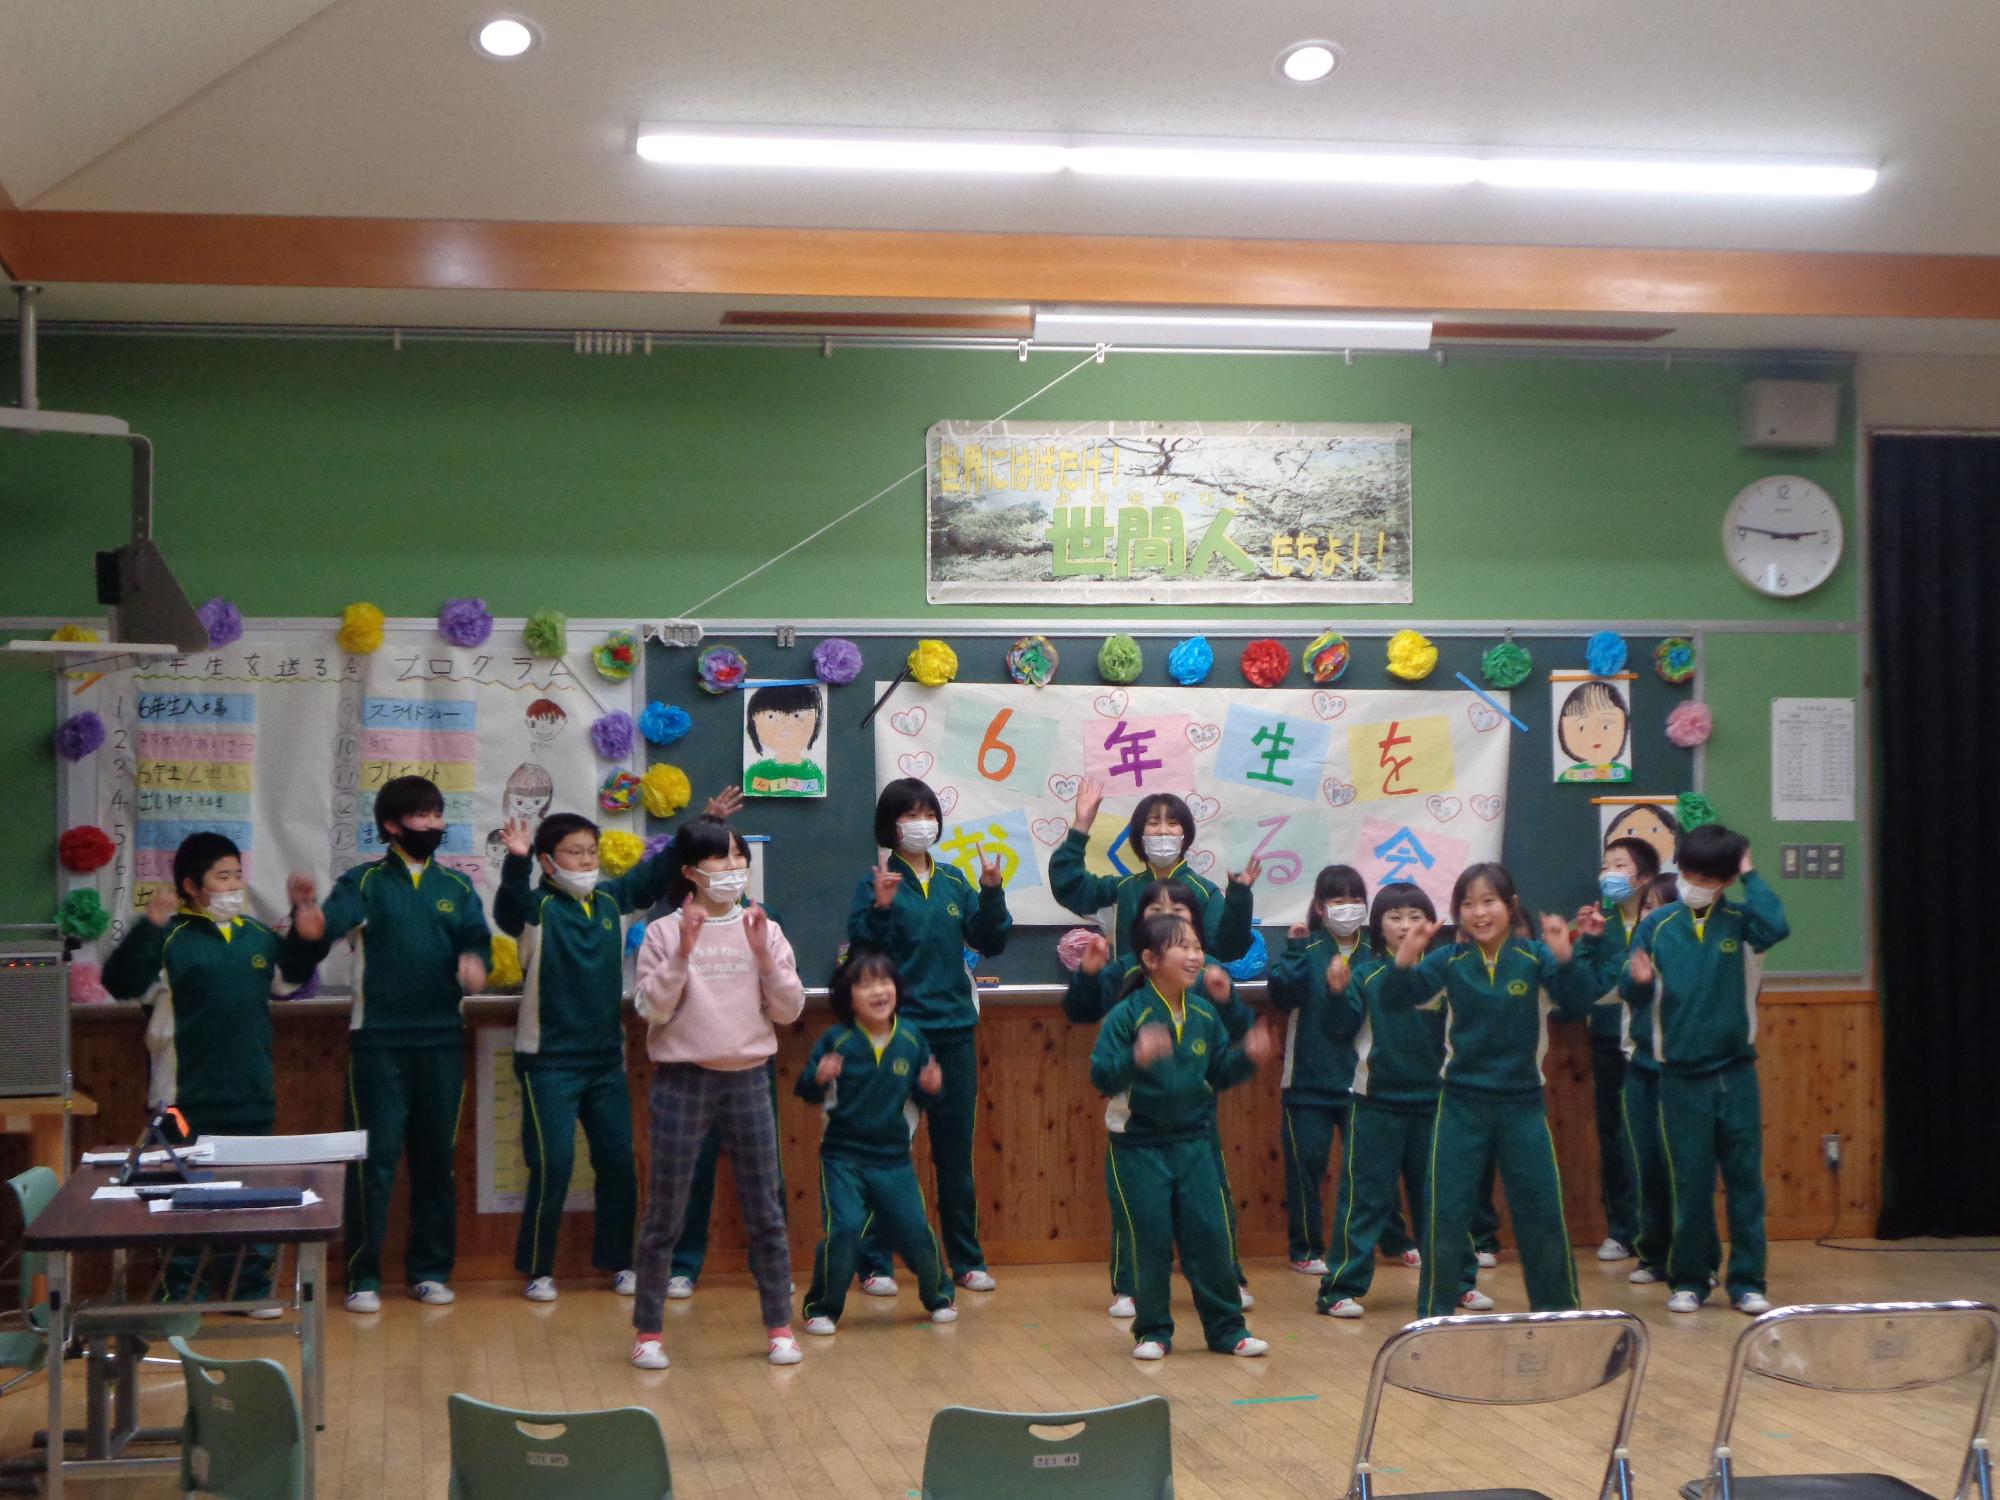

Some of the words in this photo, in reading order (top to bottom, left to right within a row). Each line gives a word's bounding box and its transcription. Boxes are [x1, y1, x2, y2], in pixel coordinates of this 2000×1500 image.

[1777, 485, 1790, 500] 12
[1045, 506, 1256, 577] 世間人
[1821, 529, 1830, 544] 3
[1777, 573, 1788, 587] 6
[395, 655, 574, 679] プログラム
[368, 703, 461, 720] スライドショー
[113, 730, 127, 749] 2
[978, 707, 1419, 795] 6年生を
[112, 758, 127, 779] 3
[111, 789, 128, 812] 4
[114, 824, 126, 846] 5
[111, 919, 124, 942] 8
